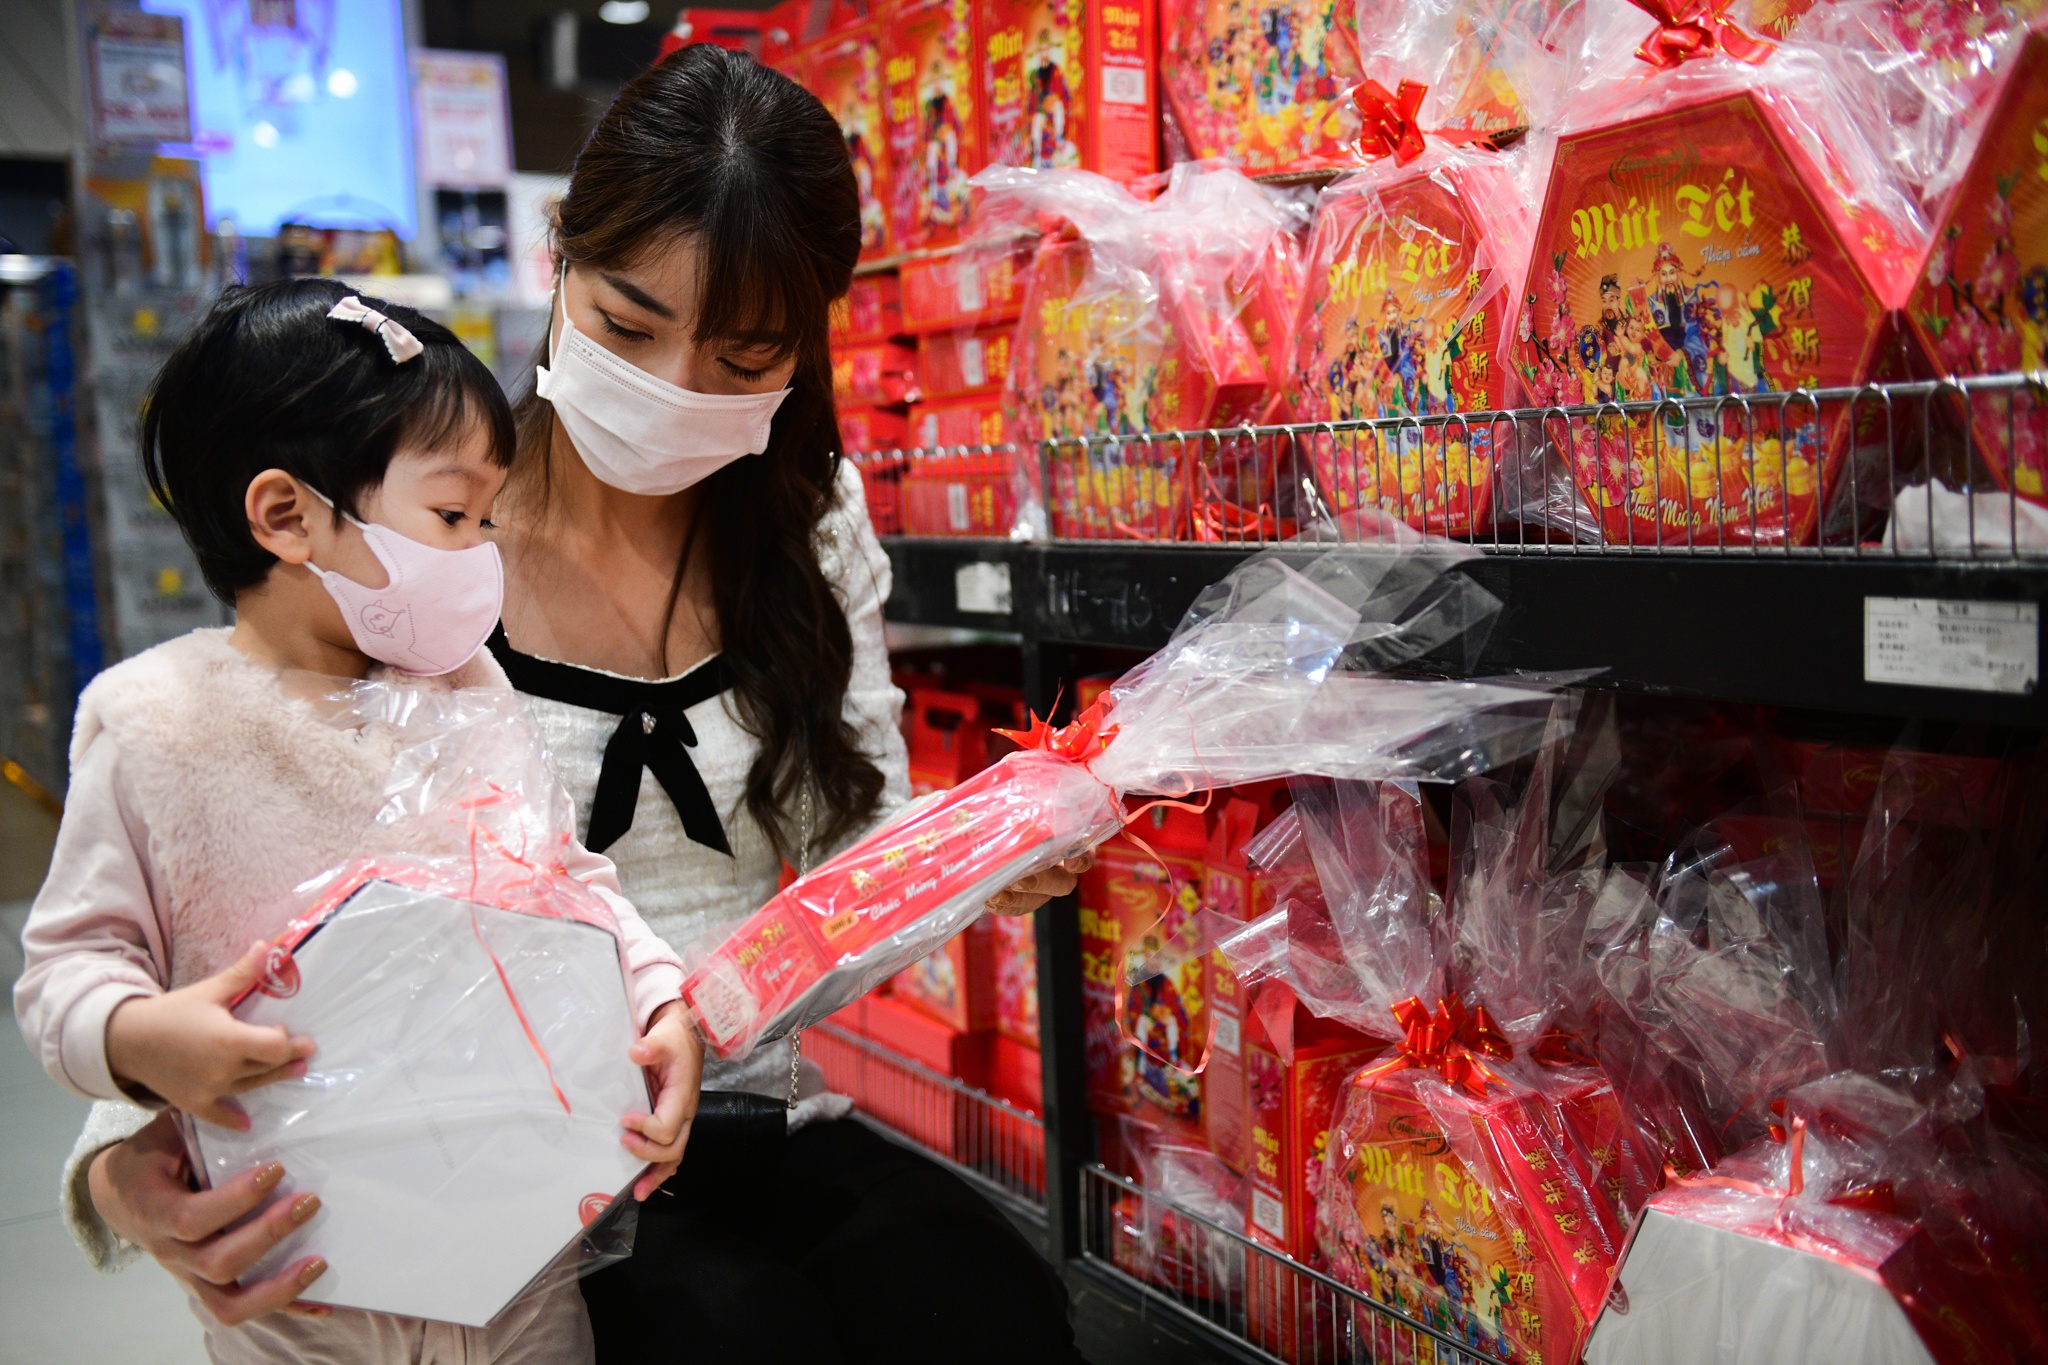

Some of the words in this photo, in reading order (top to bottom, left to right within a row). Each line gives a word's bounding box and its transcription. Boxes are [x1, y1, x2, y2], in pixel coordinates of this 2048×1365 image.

[1571, 196, 1663, 259] Mứt
[1675, 167, 1756, 239] Tết
[1360, 1145, 1426, 1199] Mứt
